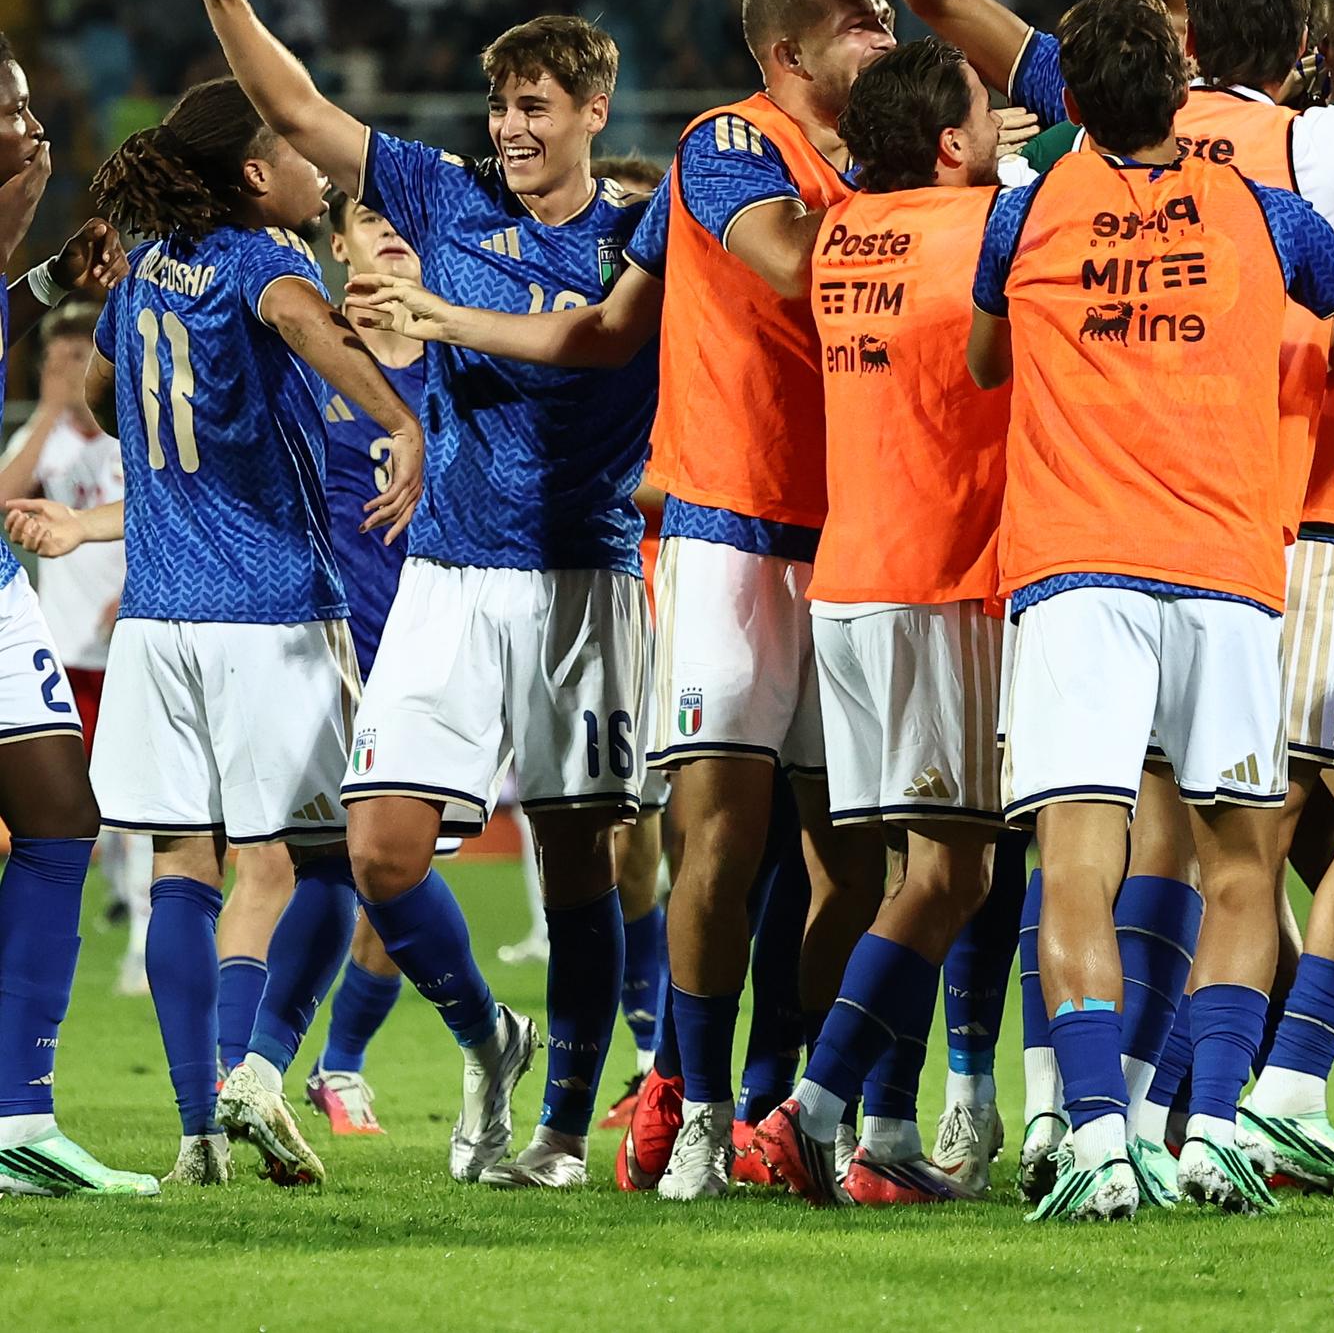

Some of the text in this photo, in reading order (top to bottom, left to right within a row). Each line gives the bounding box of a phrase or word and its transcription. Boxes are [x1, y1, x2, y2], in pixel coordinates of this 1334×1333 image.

[822, 224, 911, 256] Poste
[852, 282, 905, 315] TIM
[826, 335, 855, 372] eni
[137, 307, 199, 473] 11
[33, 648, 72, 713] 2
[583, 709, 634, 779] 16
